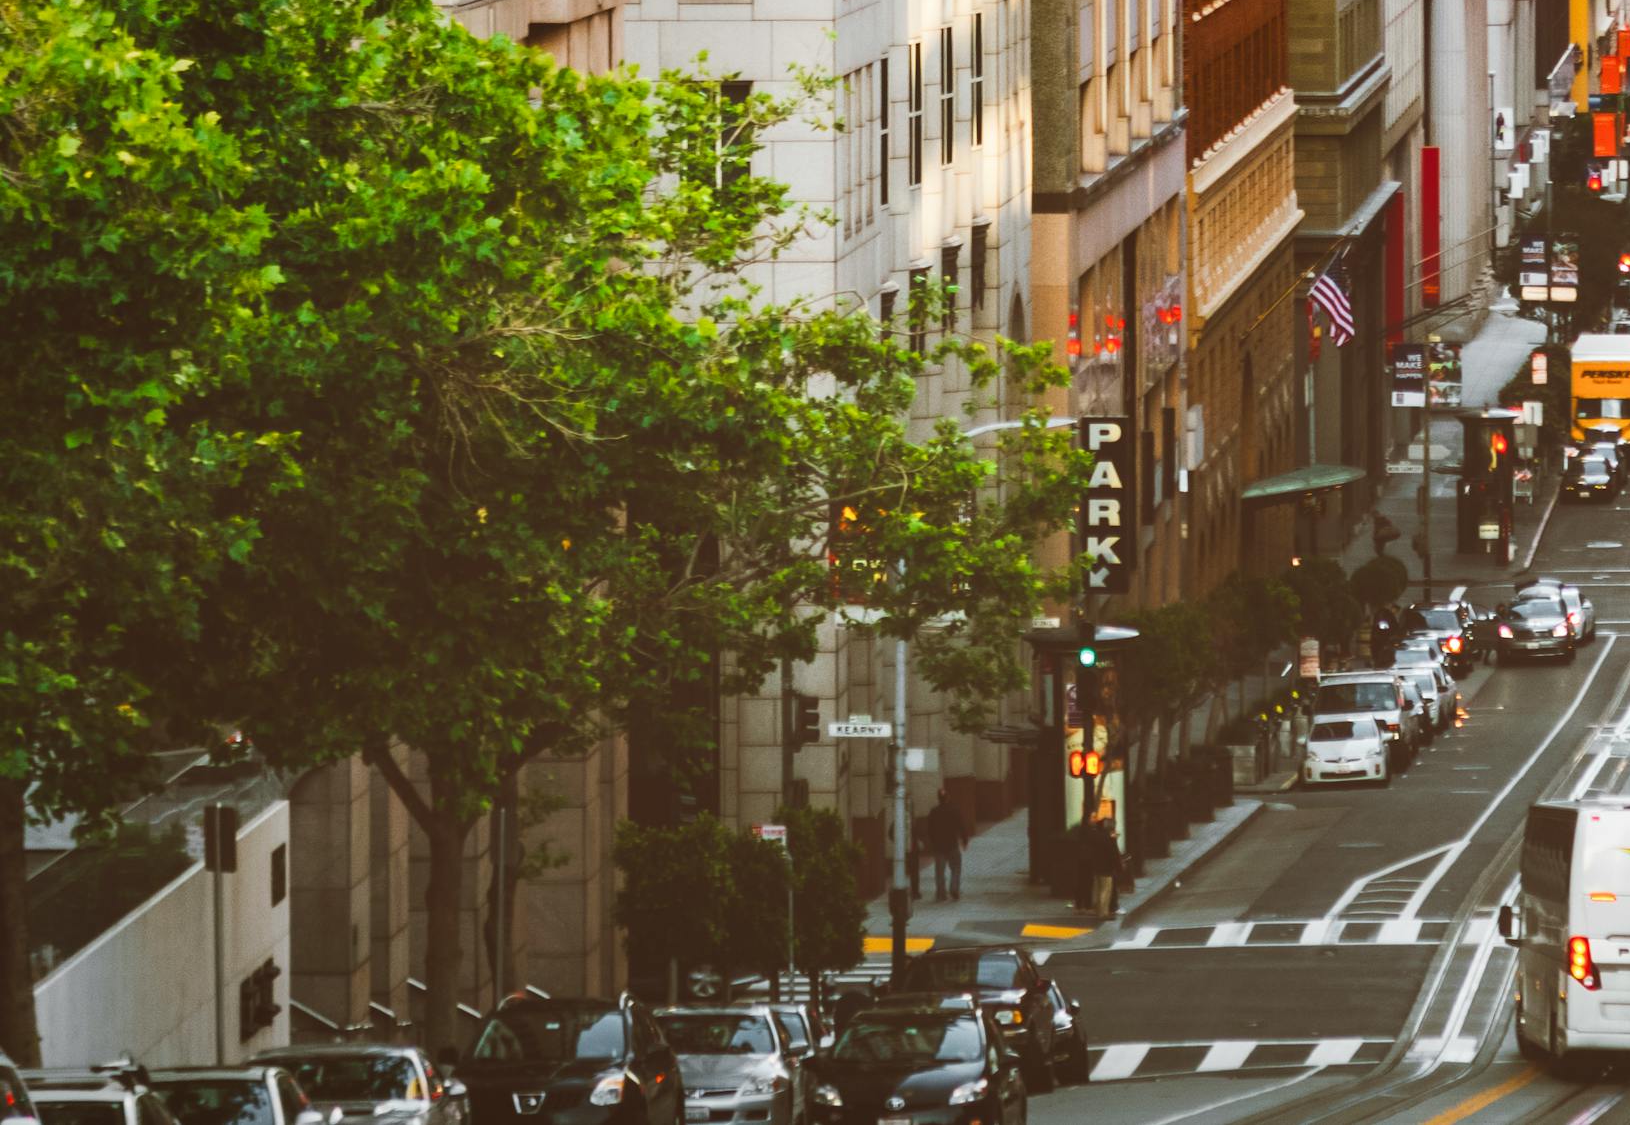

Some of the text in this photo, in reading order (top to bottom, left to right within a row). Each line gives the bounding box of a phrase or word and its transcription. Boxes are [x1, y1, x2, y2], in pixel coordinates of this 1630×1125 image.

[1395, 361, 1422, 370] MAKE
[1087, 423, 1123, 565] PARK
[836, 725, 883, 735] KEARNY
